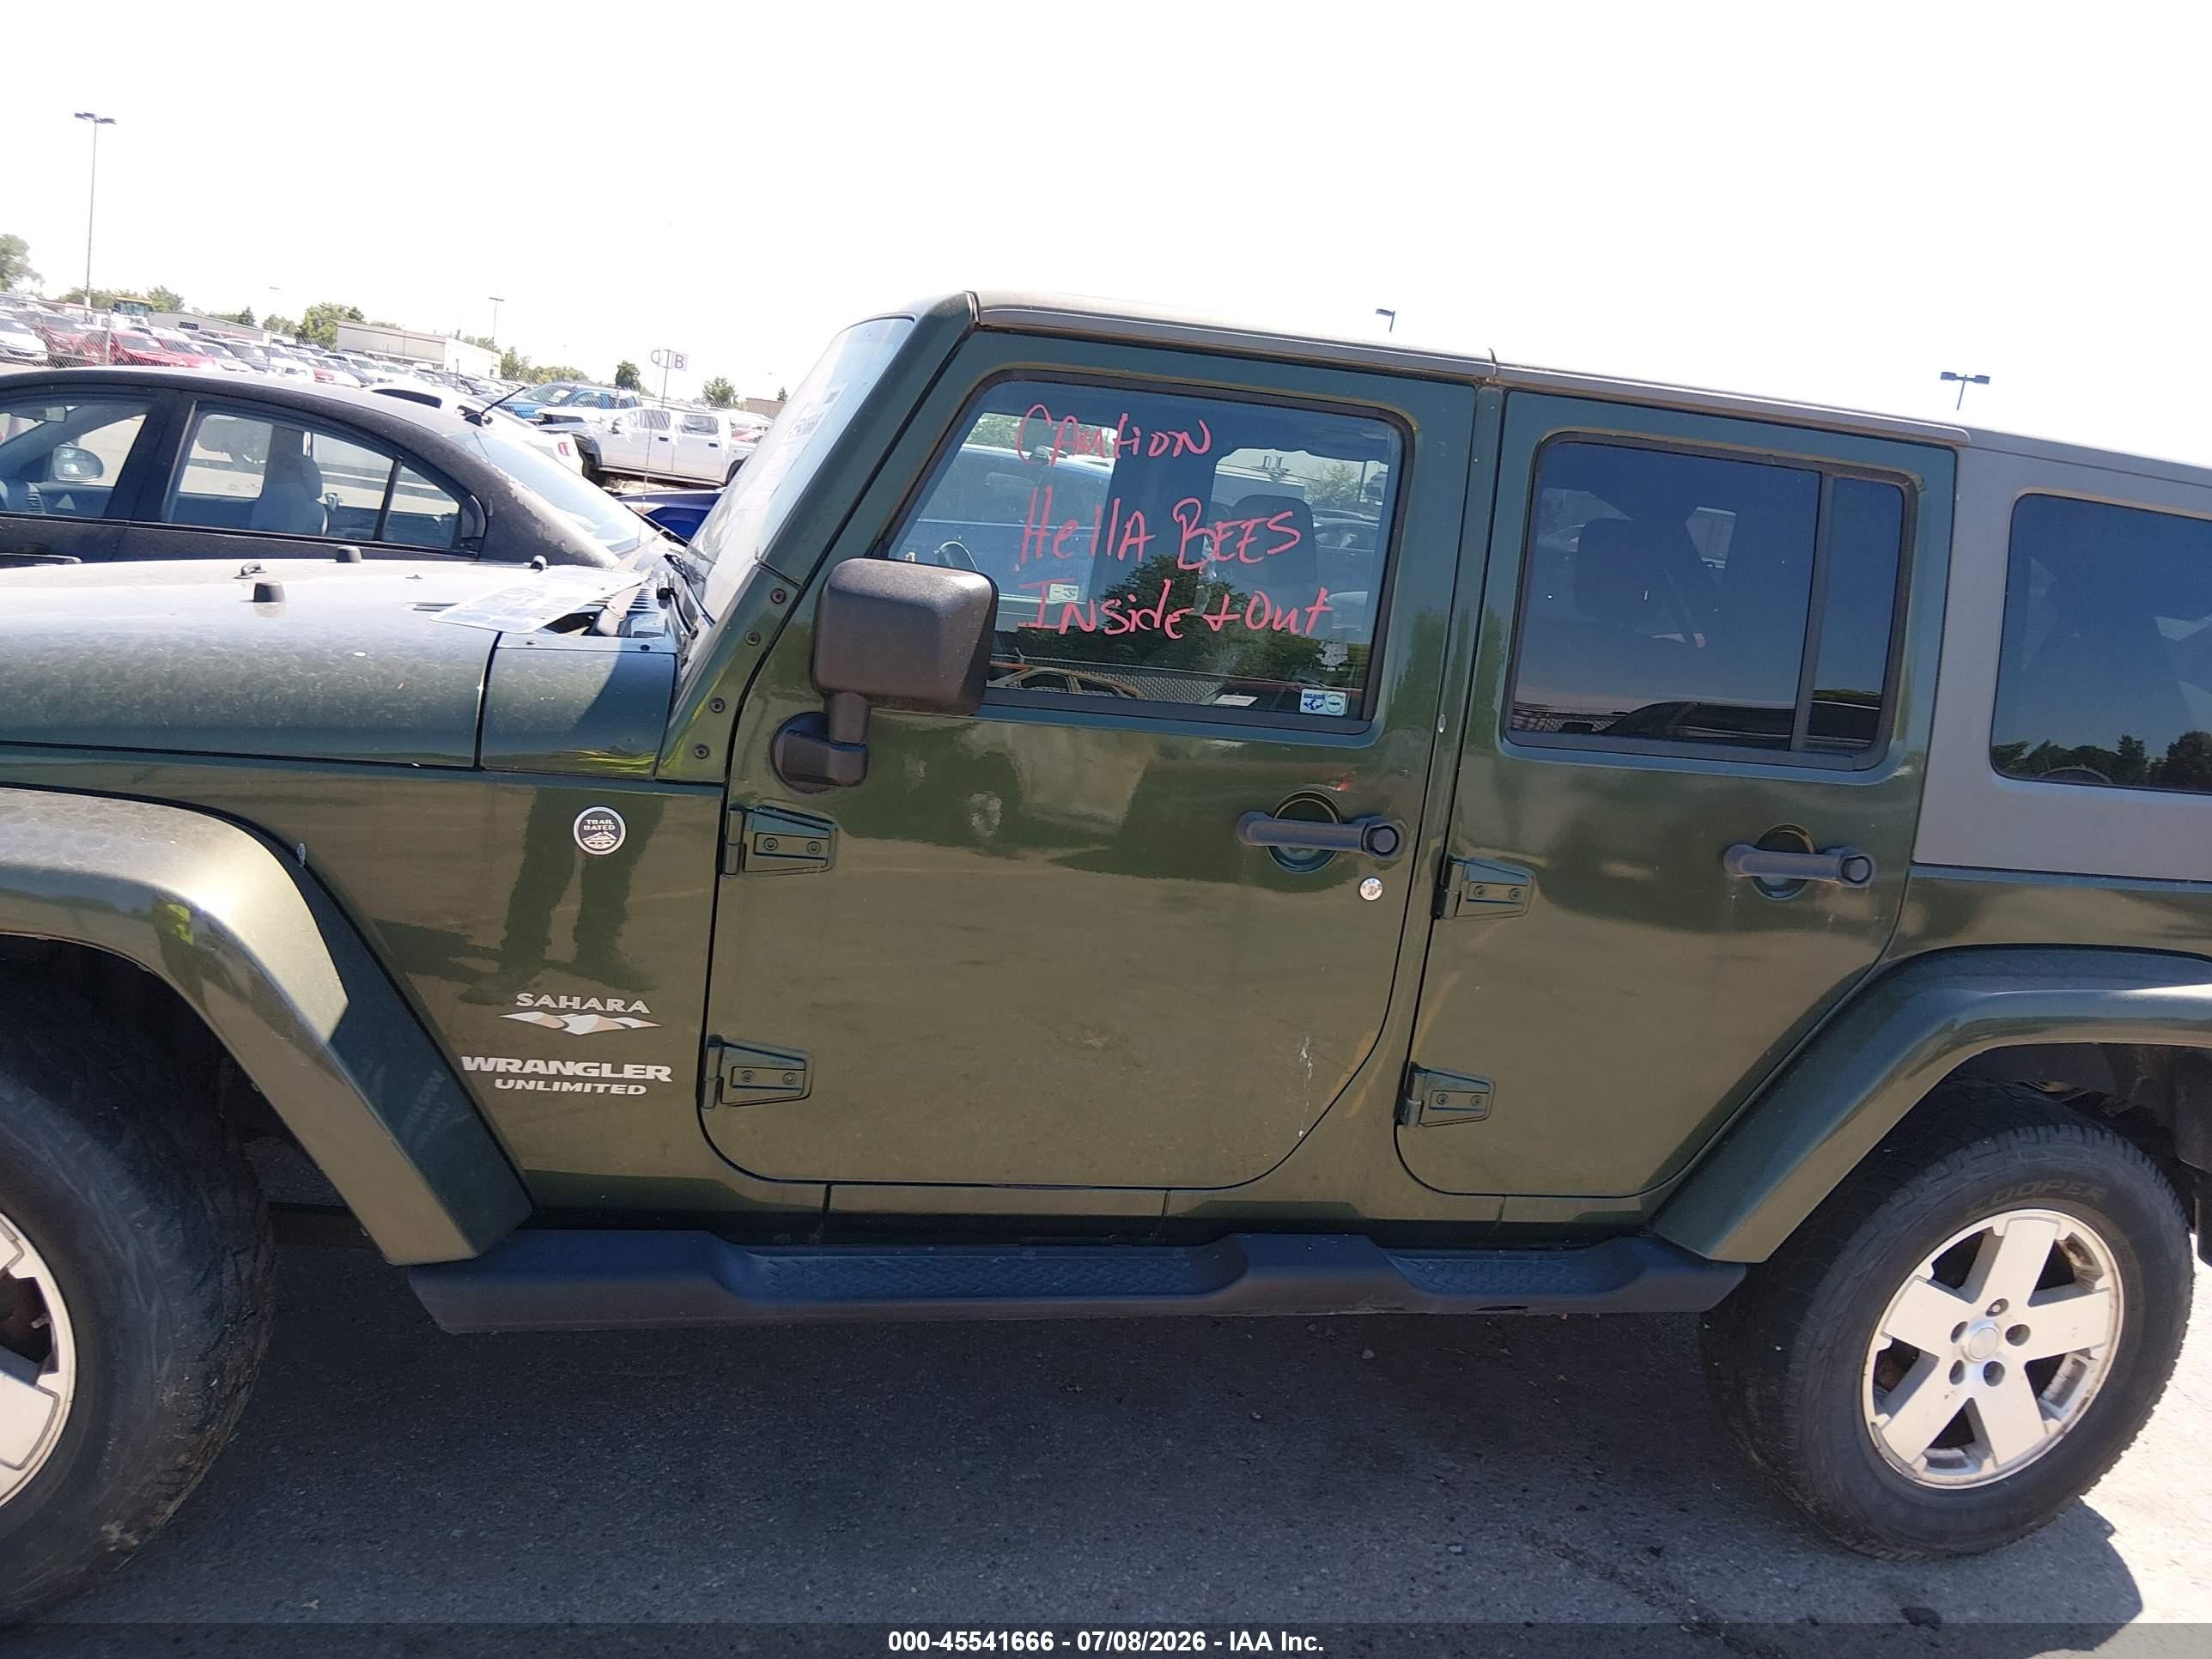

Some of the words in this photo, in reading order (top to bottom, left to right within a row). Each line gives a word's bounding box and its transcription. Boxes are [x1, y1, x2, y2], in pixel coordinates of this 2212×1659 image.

[674, 354, 684, 369] B
[1172, 497, 1302, 574] BEES
[515, 992, 652, 1015] SAHARA
[460, 1055, 673, 1083] WRANGLER
[494, 1078, 647, 1096] UNLIMITED
[1966, 1178, 2109, 1218] COOPER
